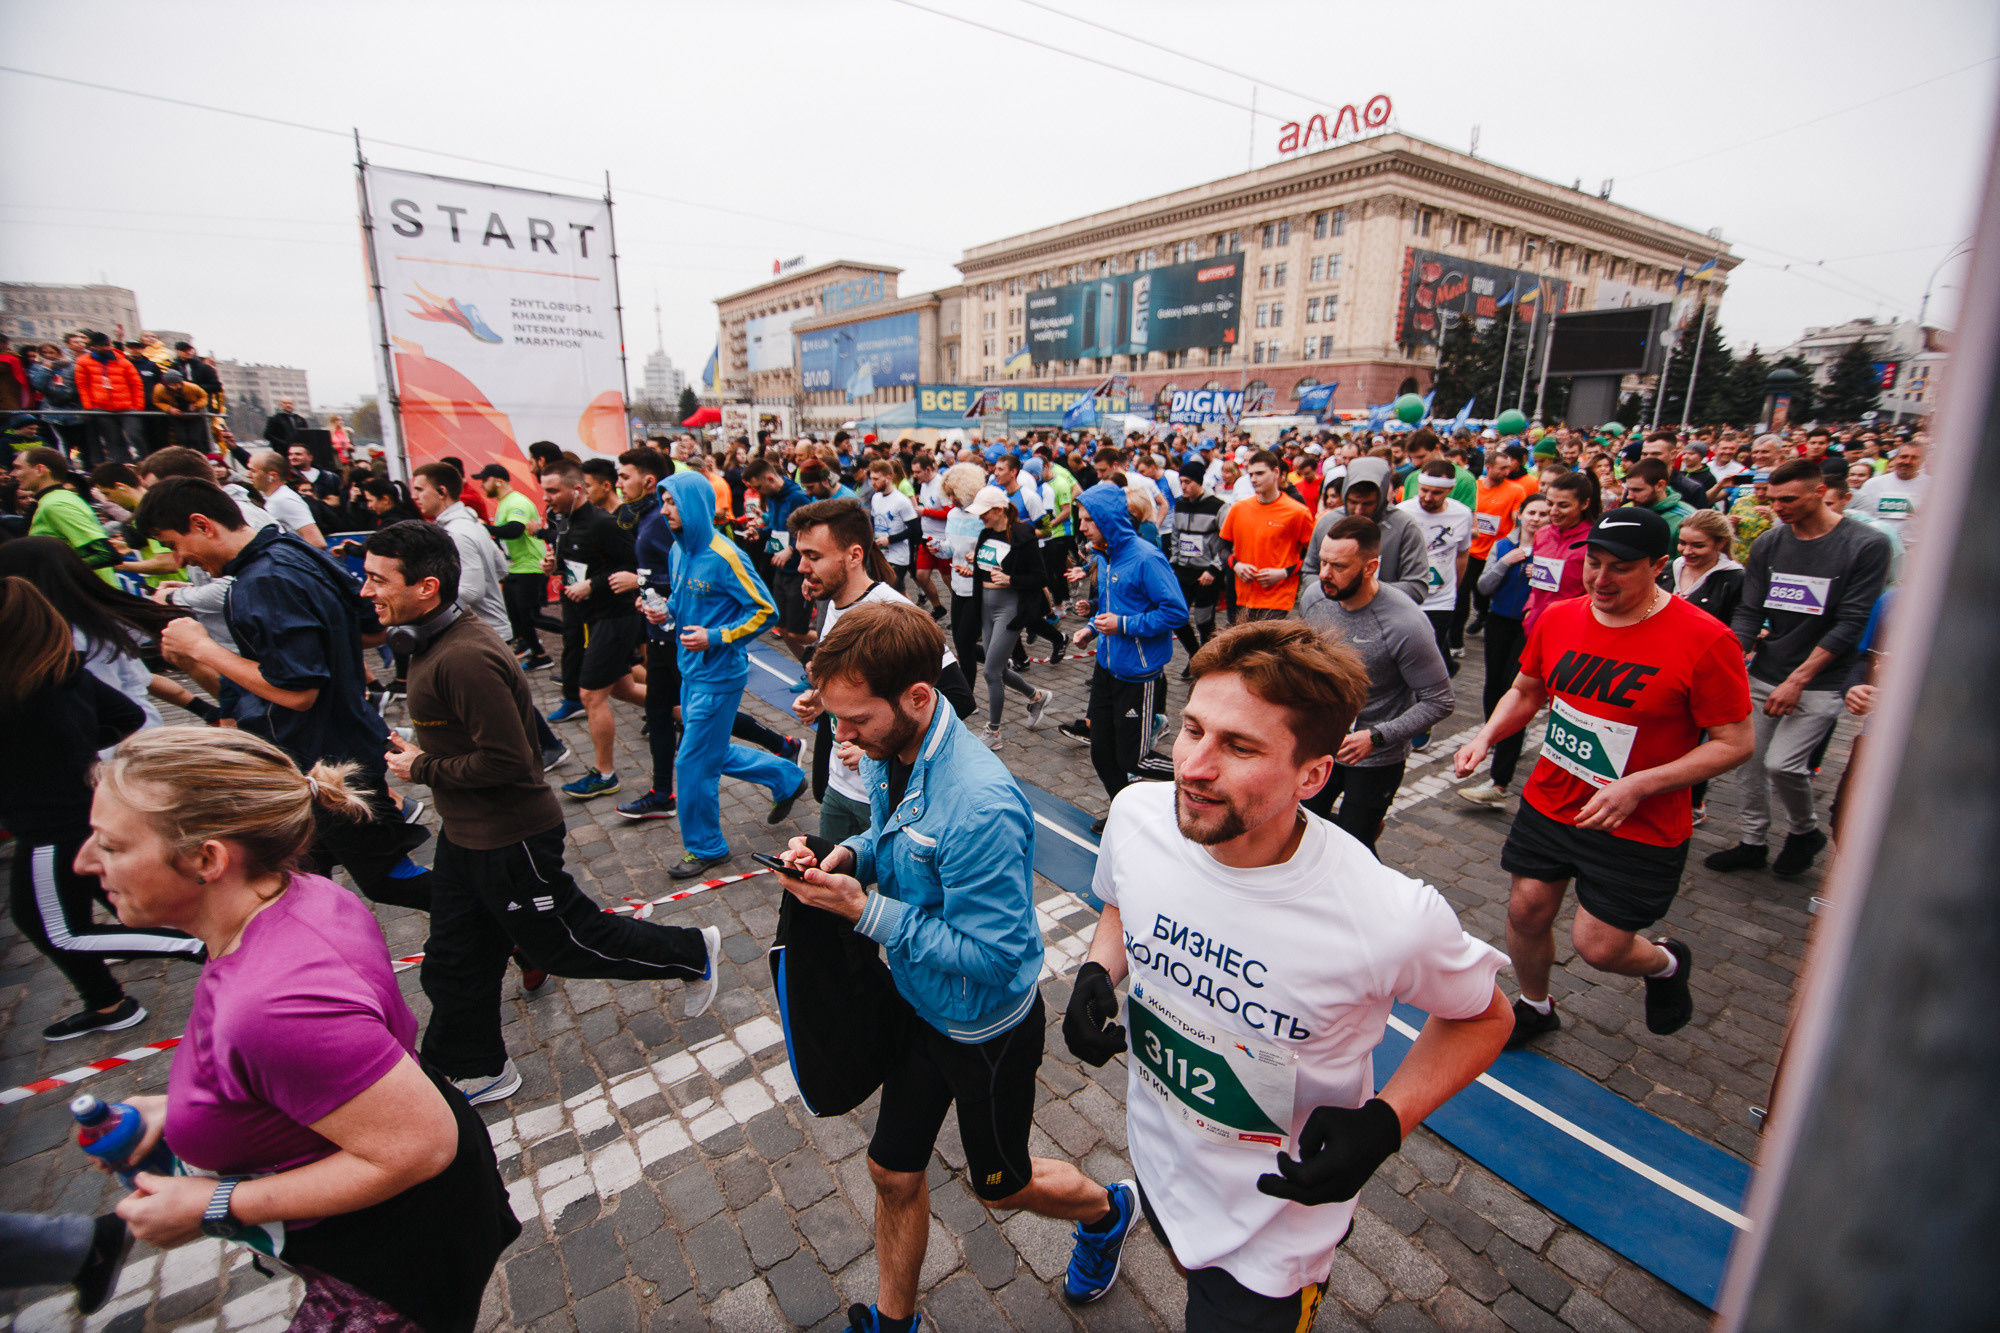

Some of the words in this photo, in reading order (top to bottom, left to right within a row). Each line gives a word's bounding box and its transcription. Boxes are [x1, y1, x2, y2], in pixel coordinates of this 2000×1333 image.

[389, 198, 595, 258] START
[510, 298, 592, 313] ZHYTLOBUD-1
[511, 311, 566, 323] KHARKIV
[513, 324, 604, 339] INTERNATIONAL
[515, 336, 581, 348] MARATHON
[921, 390, 967, 411] ВСЕ
[1769, 586, 1805, 601] 6628
[1546, 650, 1661, 708] NIKE
[1550, 723, 1593, 760] 1838
[1152, 913, 1268, 989] БИЗНЕС
[1148, 994, 1217, 1044] Жилстрой-1
[1138, 1065, 1150, 1083] 10
[1144, 1029, 1216, 1105] 3112
